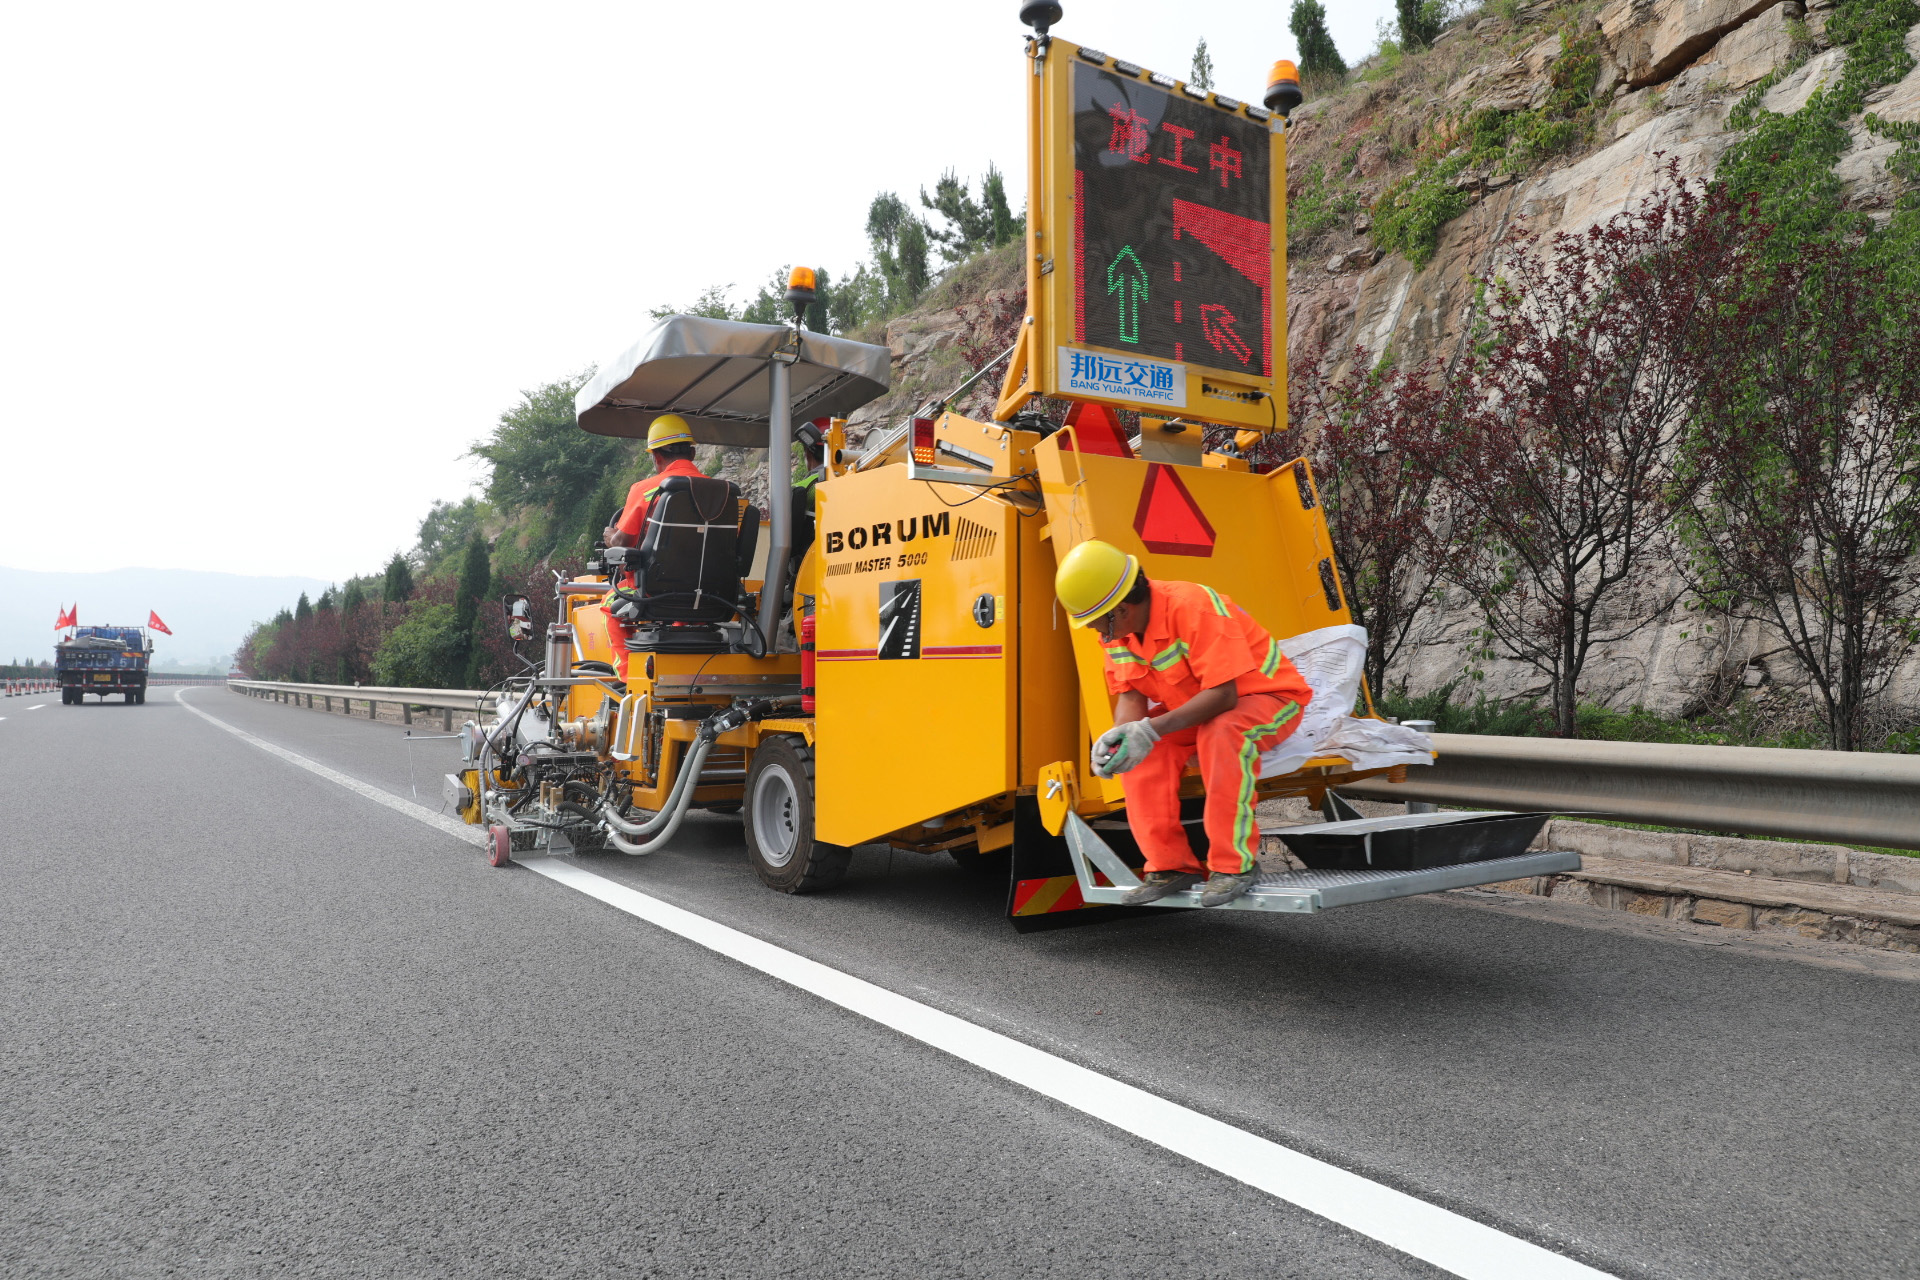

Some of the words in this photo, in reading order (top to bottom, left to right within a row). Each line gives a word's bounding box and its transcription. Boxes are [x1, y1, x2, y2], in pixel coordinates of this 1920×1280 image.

[1108, 101, 1243, 188] 施工中
[1070, 352, 1174, 392] 邦远交通
[1070, 379, 1100, 391] BANG
[1102, 383, 1131, 395] YUAN
[1133, 387, 1174, 401] TRAFFIC
[826, 511, 950, 554] BORUM
[854, 556, 892, 574] MASTER
[896, 551, 928, 568] 5000
